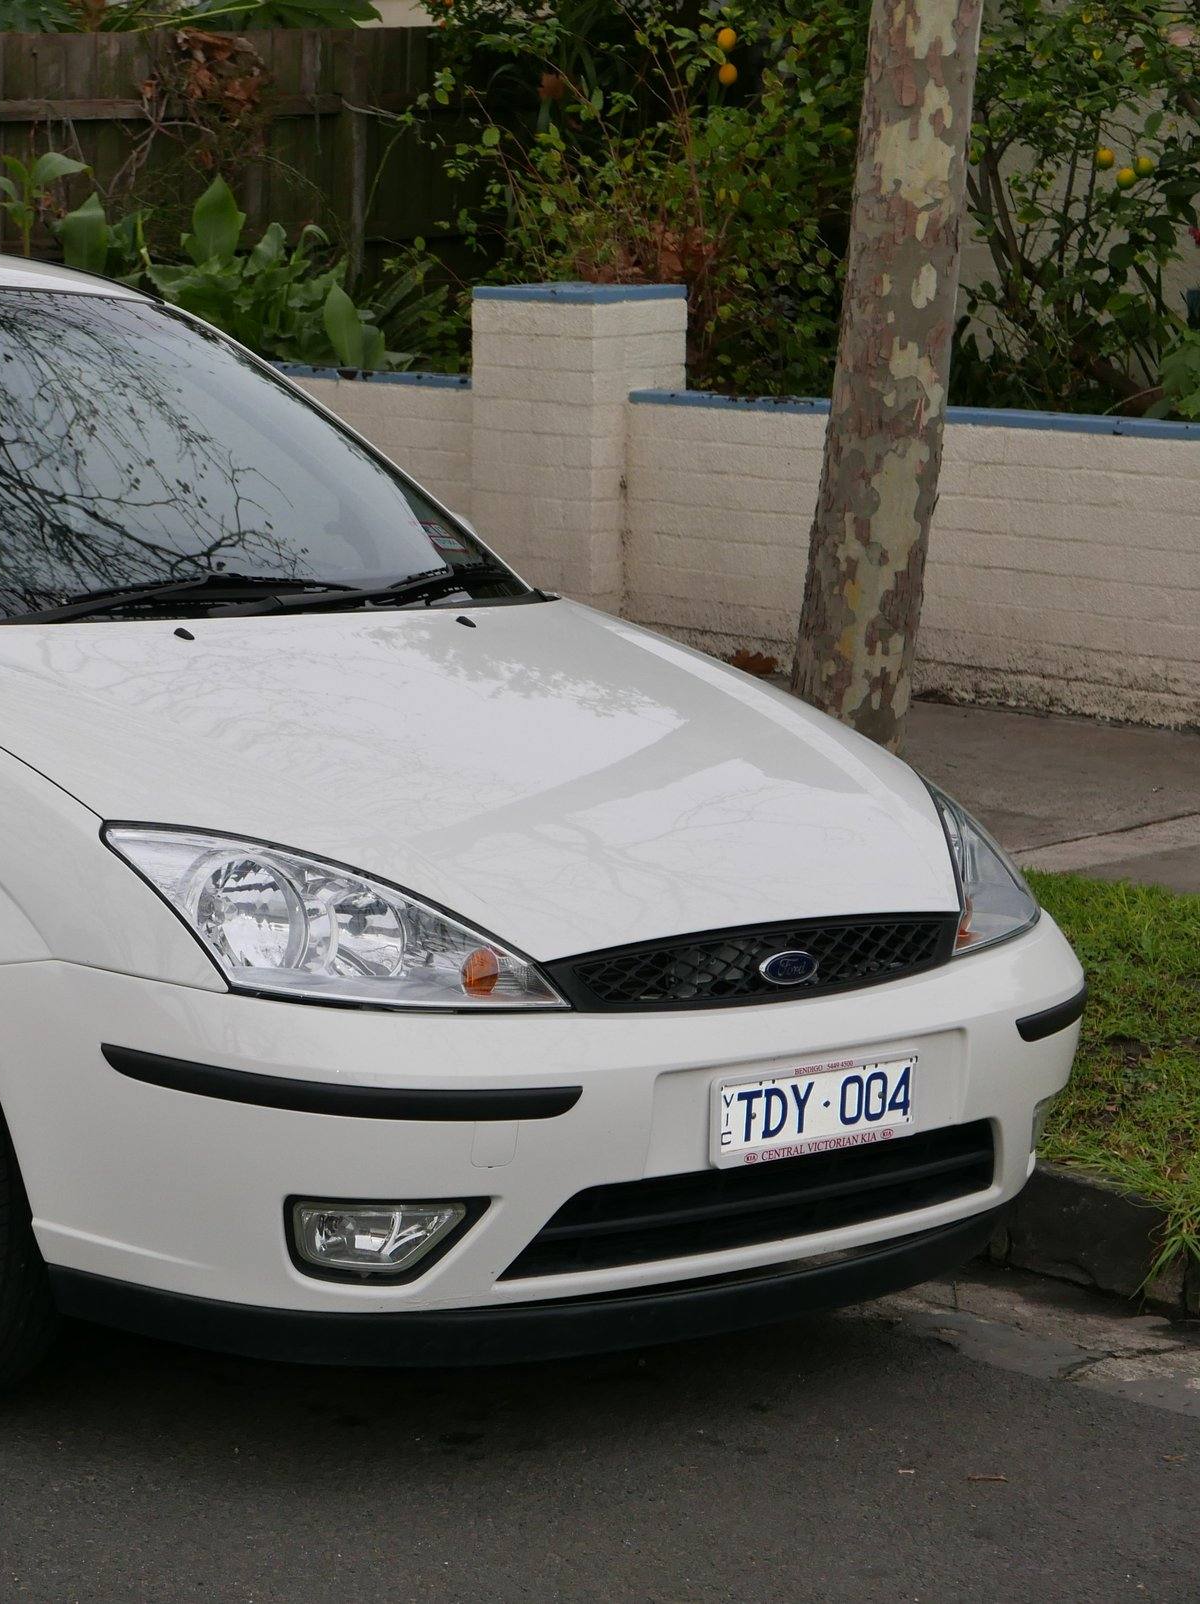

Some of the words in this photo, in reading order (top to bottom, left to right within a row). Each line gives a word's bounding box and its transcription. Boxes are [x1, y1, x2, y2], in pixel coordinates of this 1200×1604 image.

[794, 1064, 823, 1075] BENDIGO
[761, 1144, 806, 1161] CENTRAL
[807, 1134, 859, 1153] VICTORIAN
[860, 1131, 877, 1144] KIA
